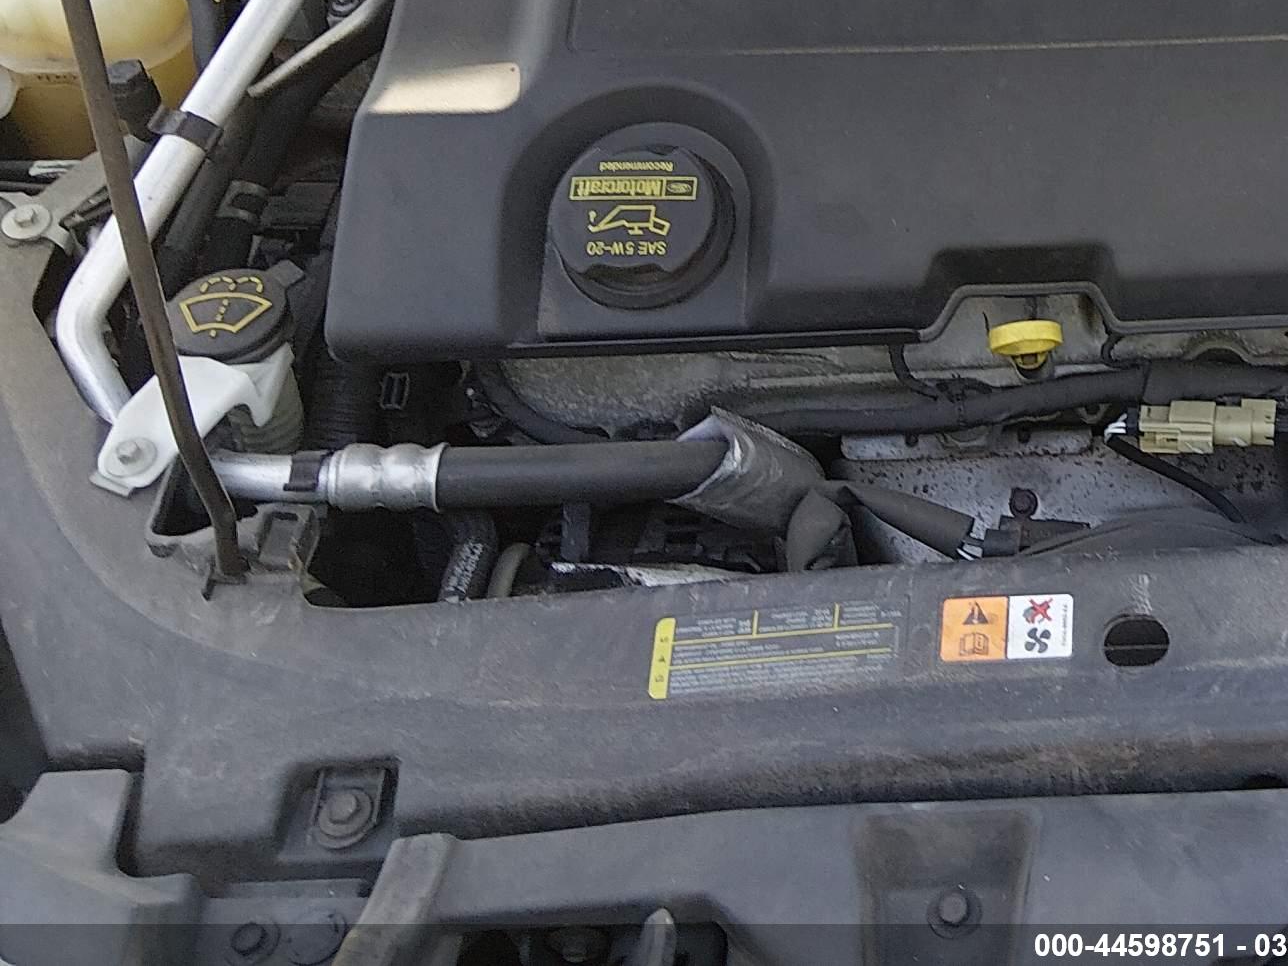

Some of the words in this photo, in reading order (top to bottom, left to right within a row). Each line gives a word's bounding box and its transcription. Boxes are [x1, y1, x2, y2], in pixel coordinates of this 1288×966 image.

[600, 161, 674, 172] Recommended
[577, 178, 662, 196] Motorcraft
[587, 241, 635, 255] 5W-20
[638, 241, 667, 255] SAE
